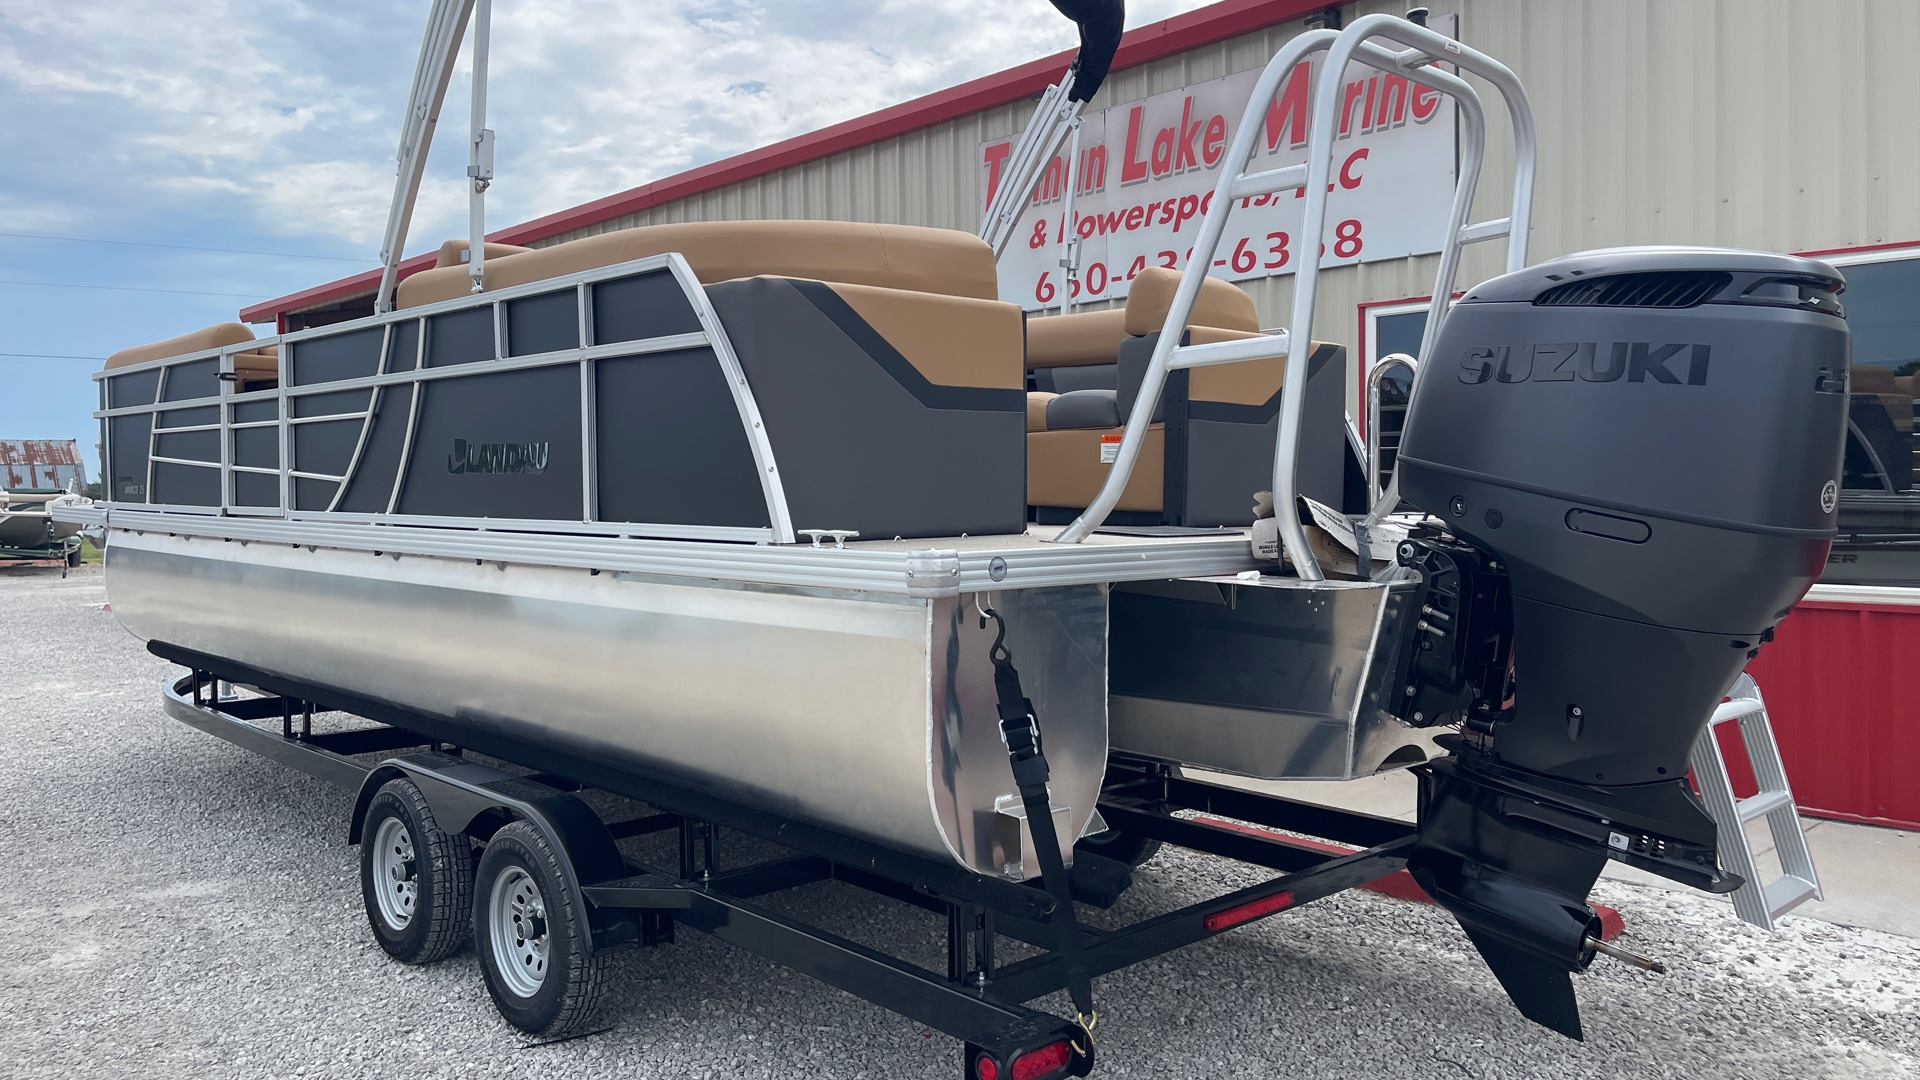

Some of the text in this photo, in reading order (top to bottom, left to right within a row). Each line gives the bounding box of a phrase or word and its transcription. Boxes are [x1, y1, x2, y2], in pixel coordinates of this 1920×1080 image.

[1121, 96, 1227, 186] Lake
[1258, 61, 1440, 156] Mrine
[1029, 219, 1047, 249] &
[1457, 342, 1711, 386] SUZUKI
[466, 442, 549, 474] LANDAU
